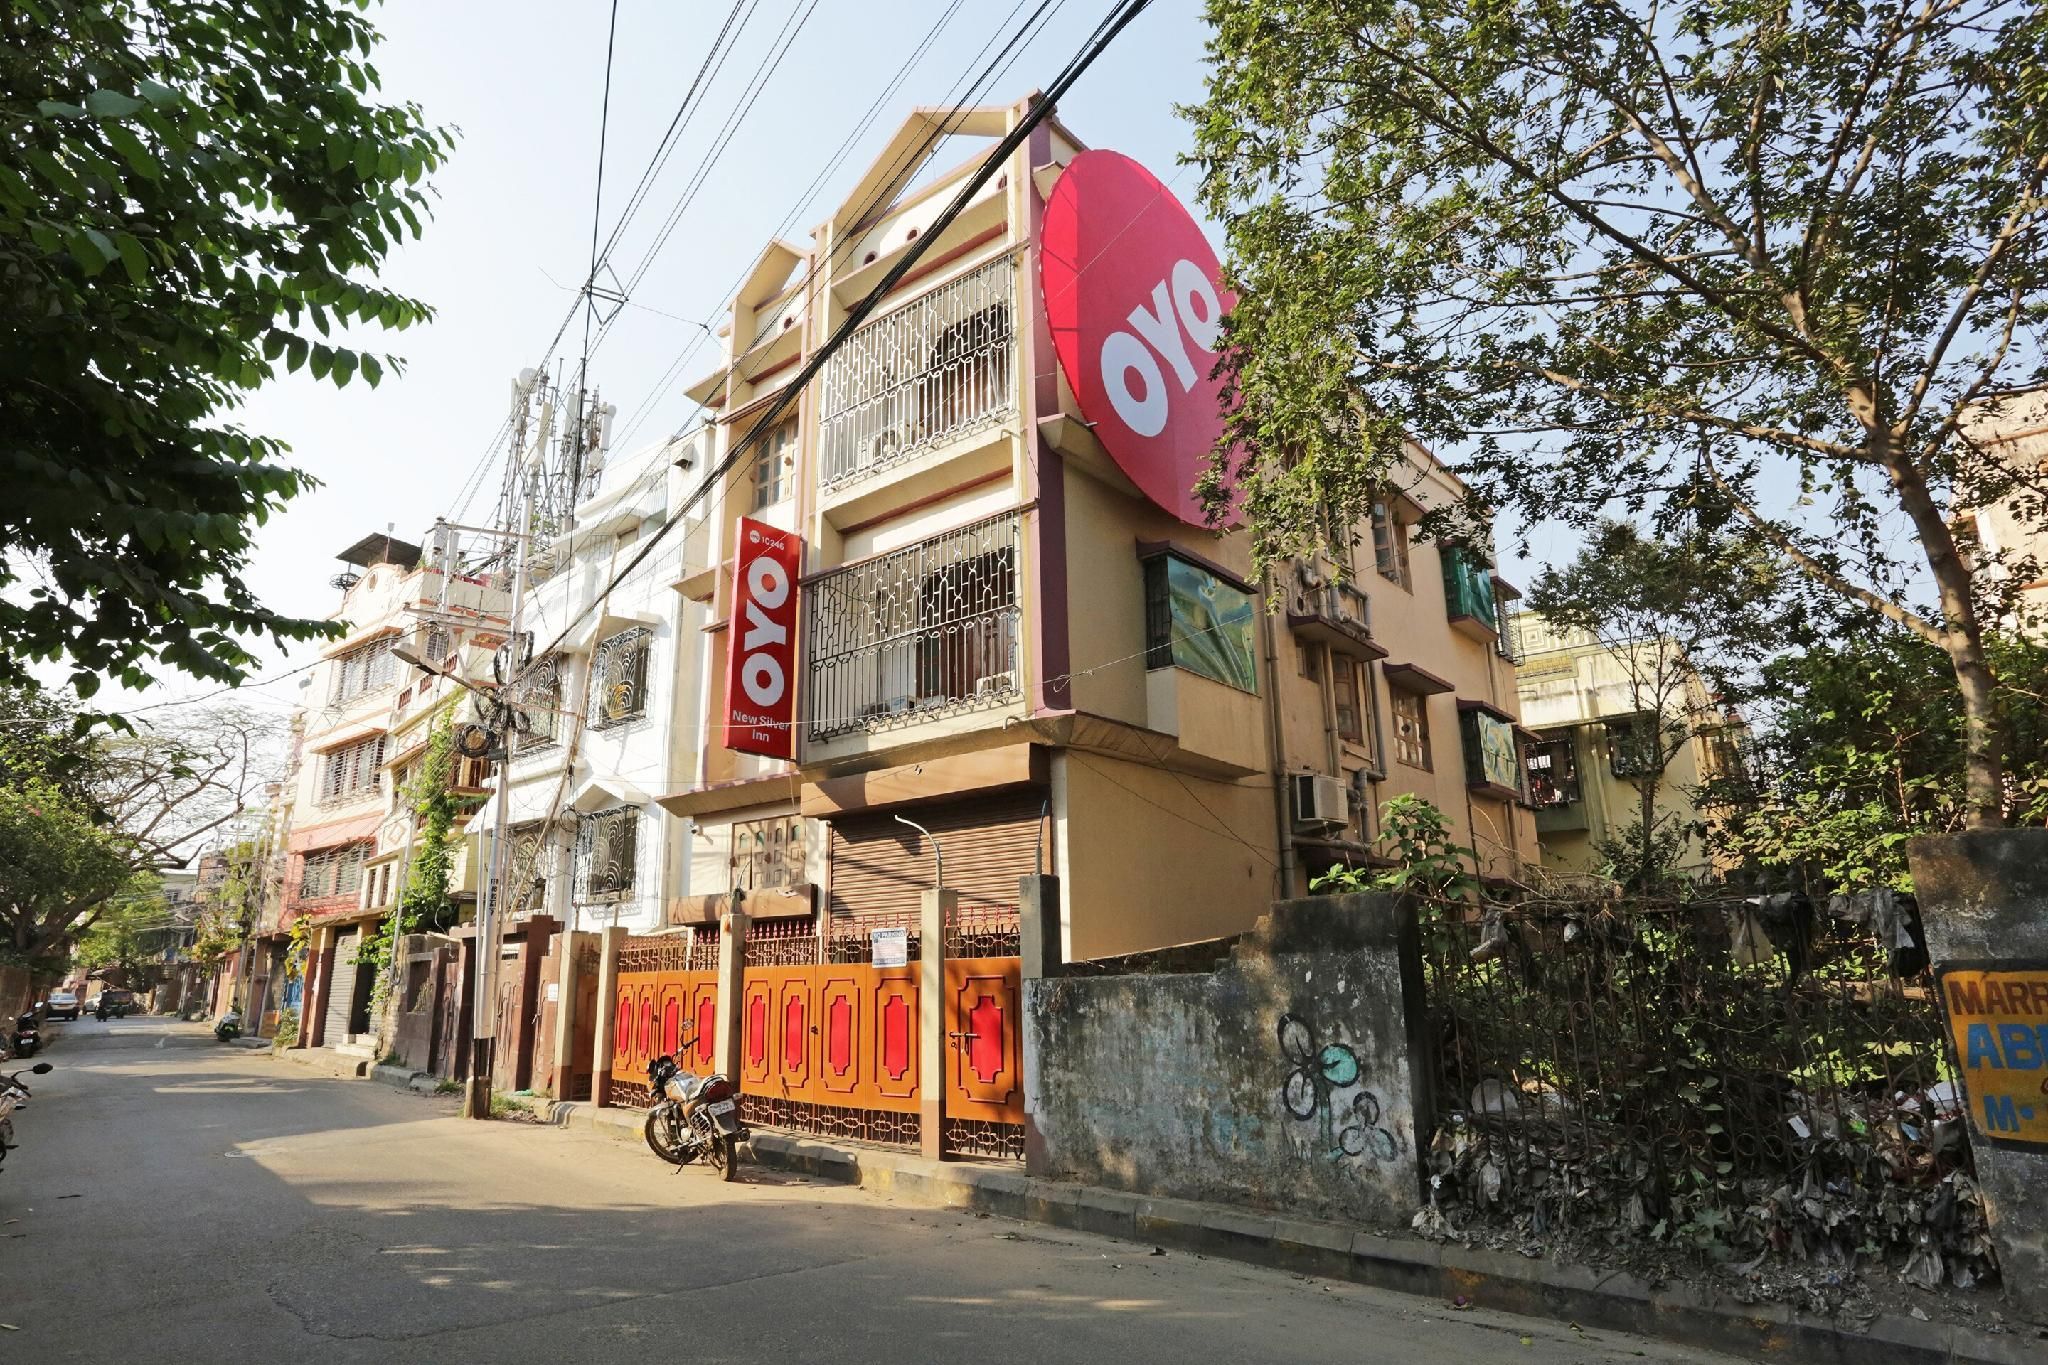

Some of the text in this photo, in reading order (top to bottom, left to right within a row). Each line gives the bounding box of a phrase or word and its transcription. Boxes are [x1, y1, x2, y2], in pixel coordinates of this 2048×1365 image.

[1101, 259, 1224, 437] OYO
[741, 556, 790, 707] OYO
[732, 709, 790, 731] New Silver
[752, 728, 770, 742] Inn
